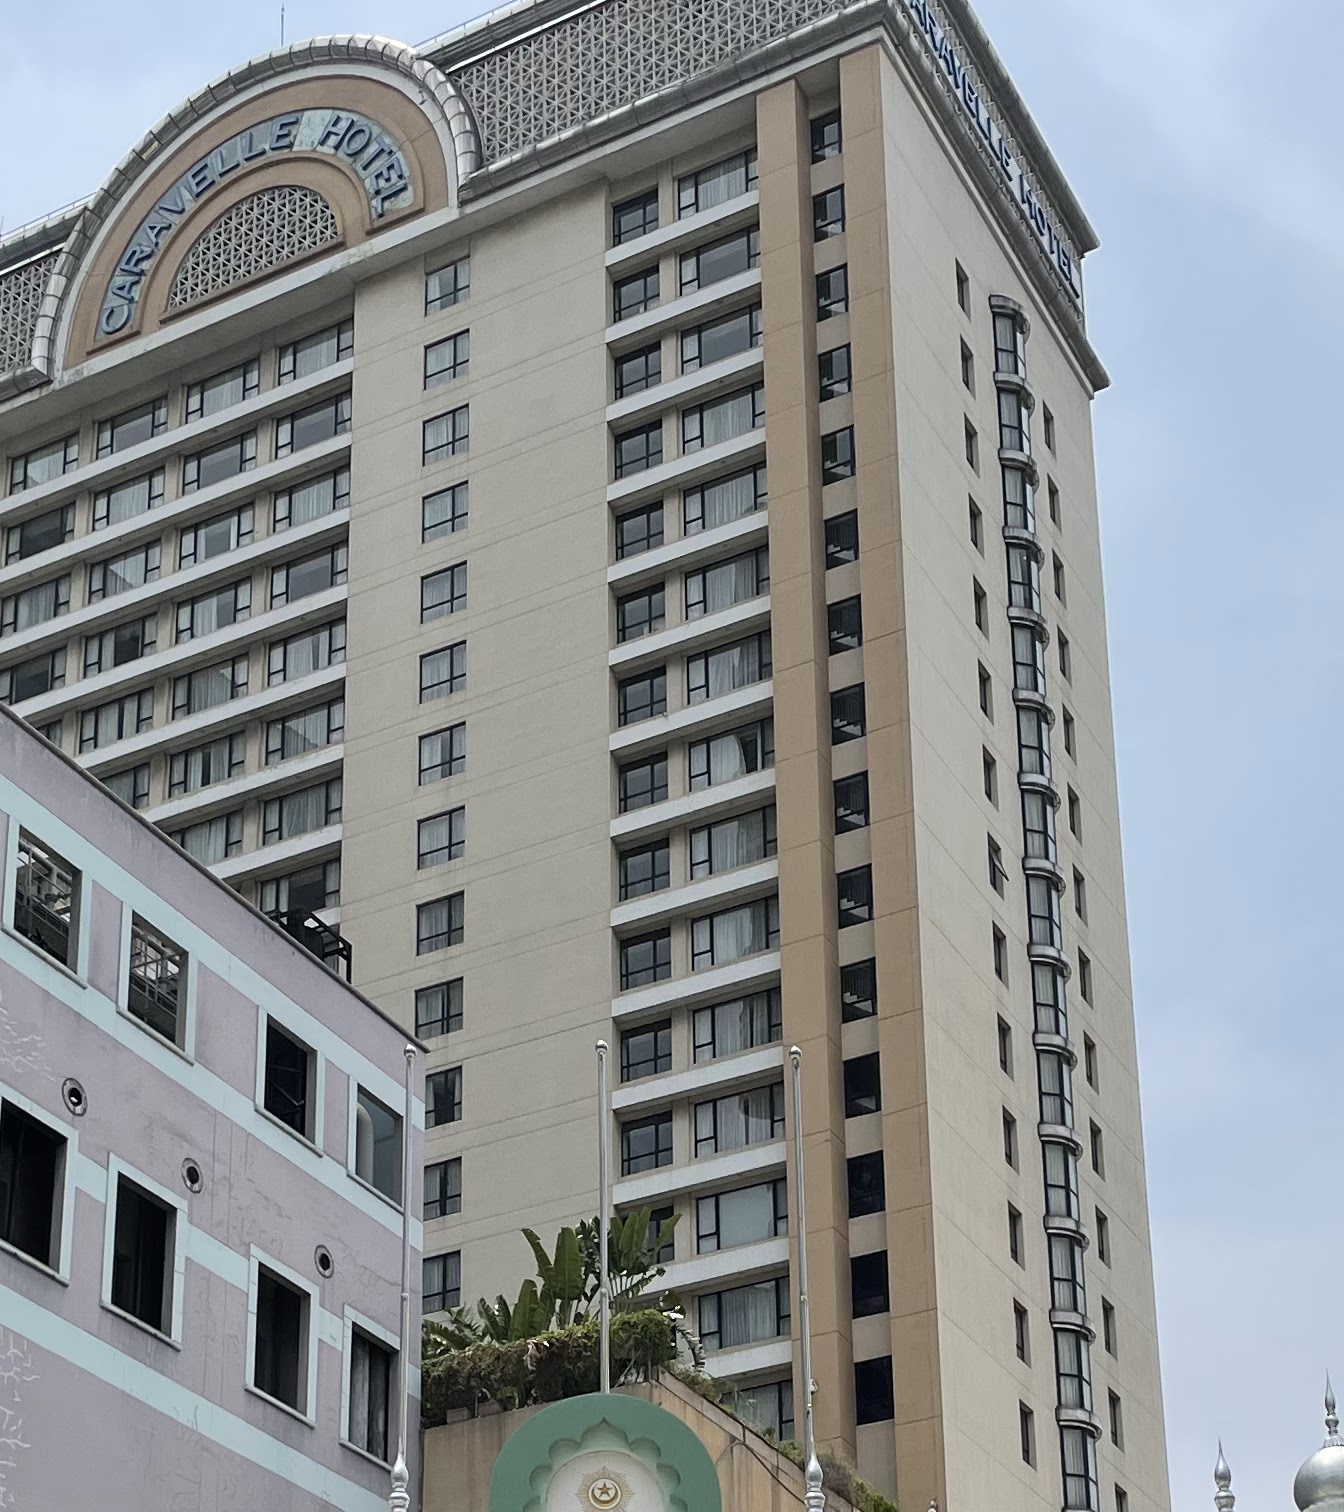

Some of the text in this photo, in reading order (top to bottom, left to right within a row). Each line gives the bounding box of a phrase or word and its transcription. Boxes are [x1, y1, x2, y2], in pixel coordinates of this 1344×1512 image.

[102, 113, 410, 335] CARAVELLE HOTEL
[1019, 173, 1080, 299] HOTEL
